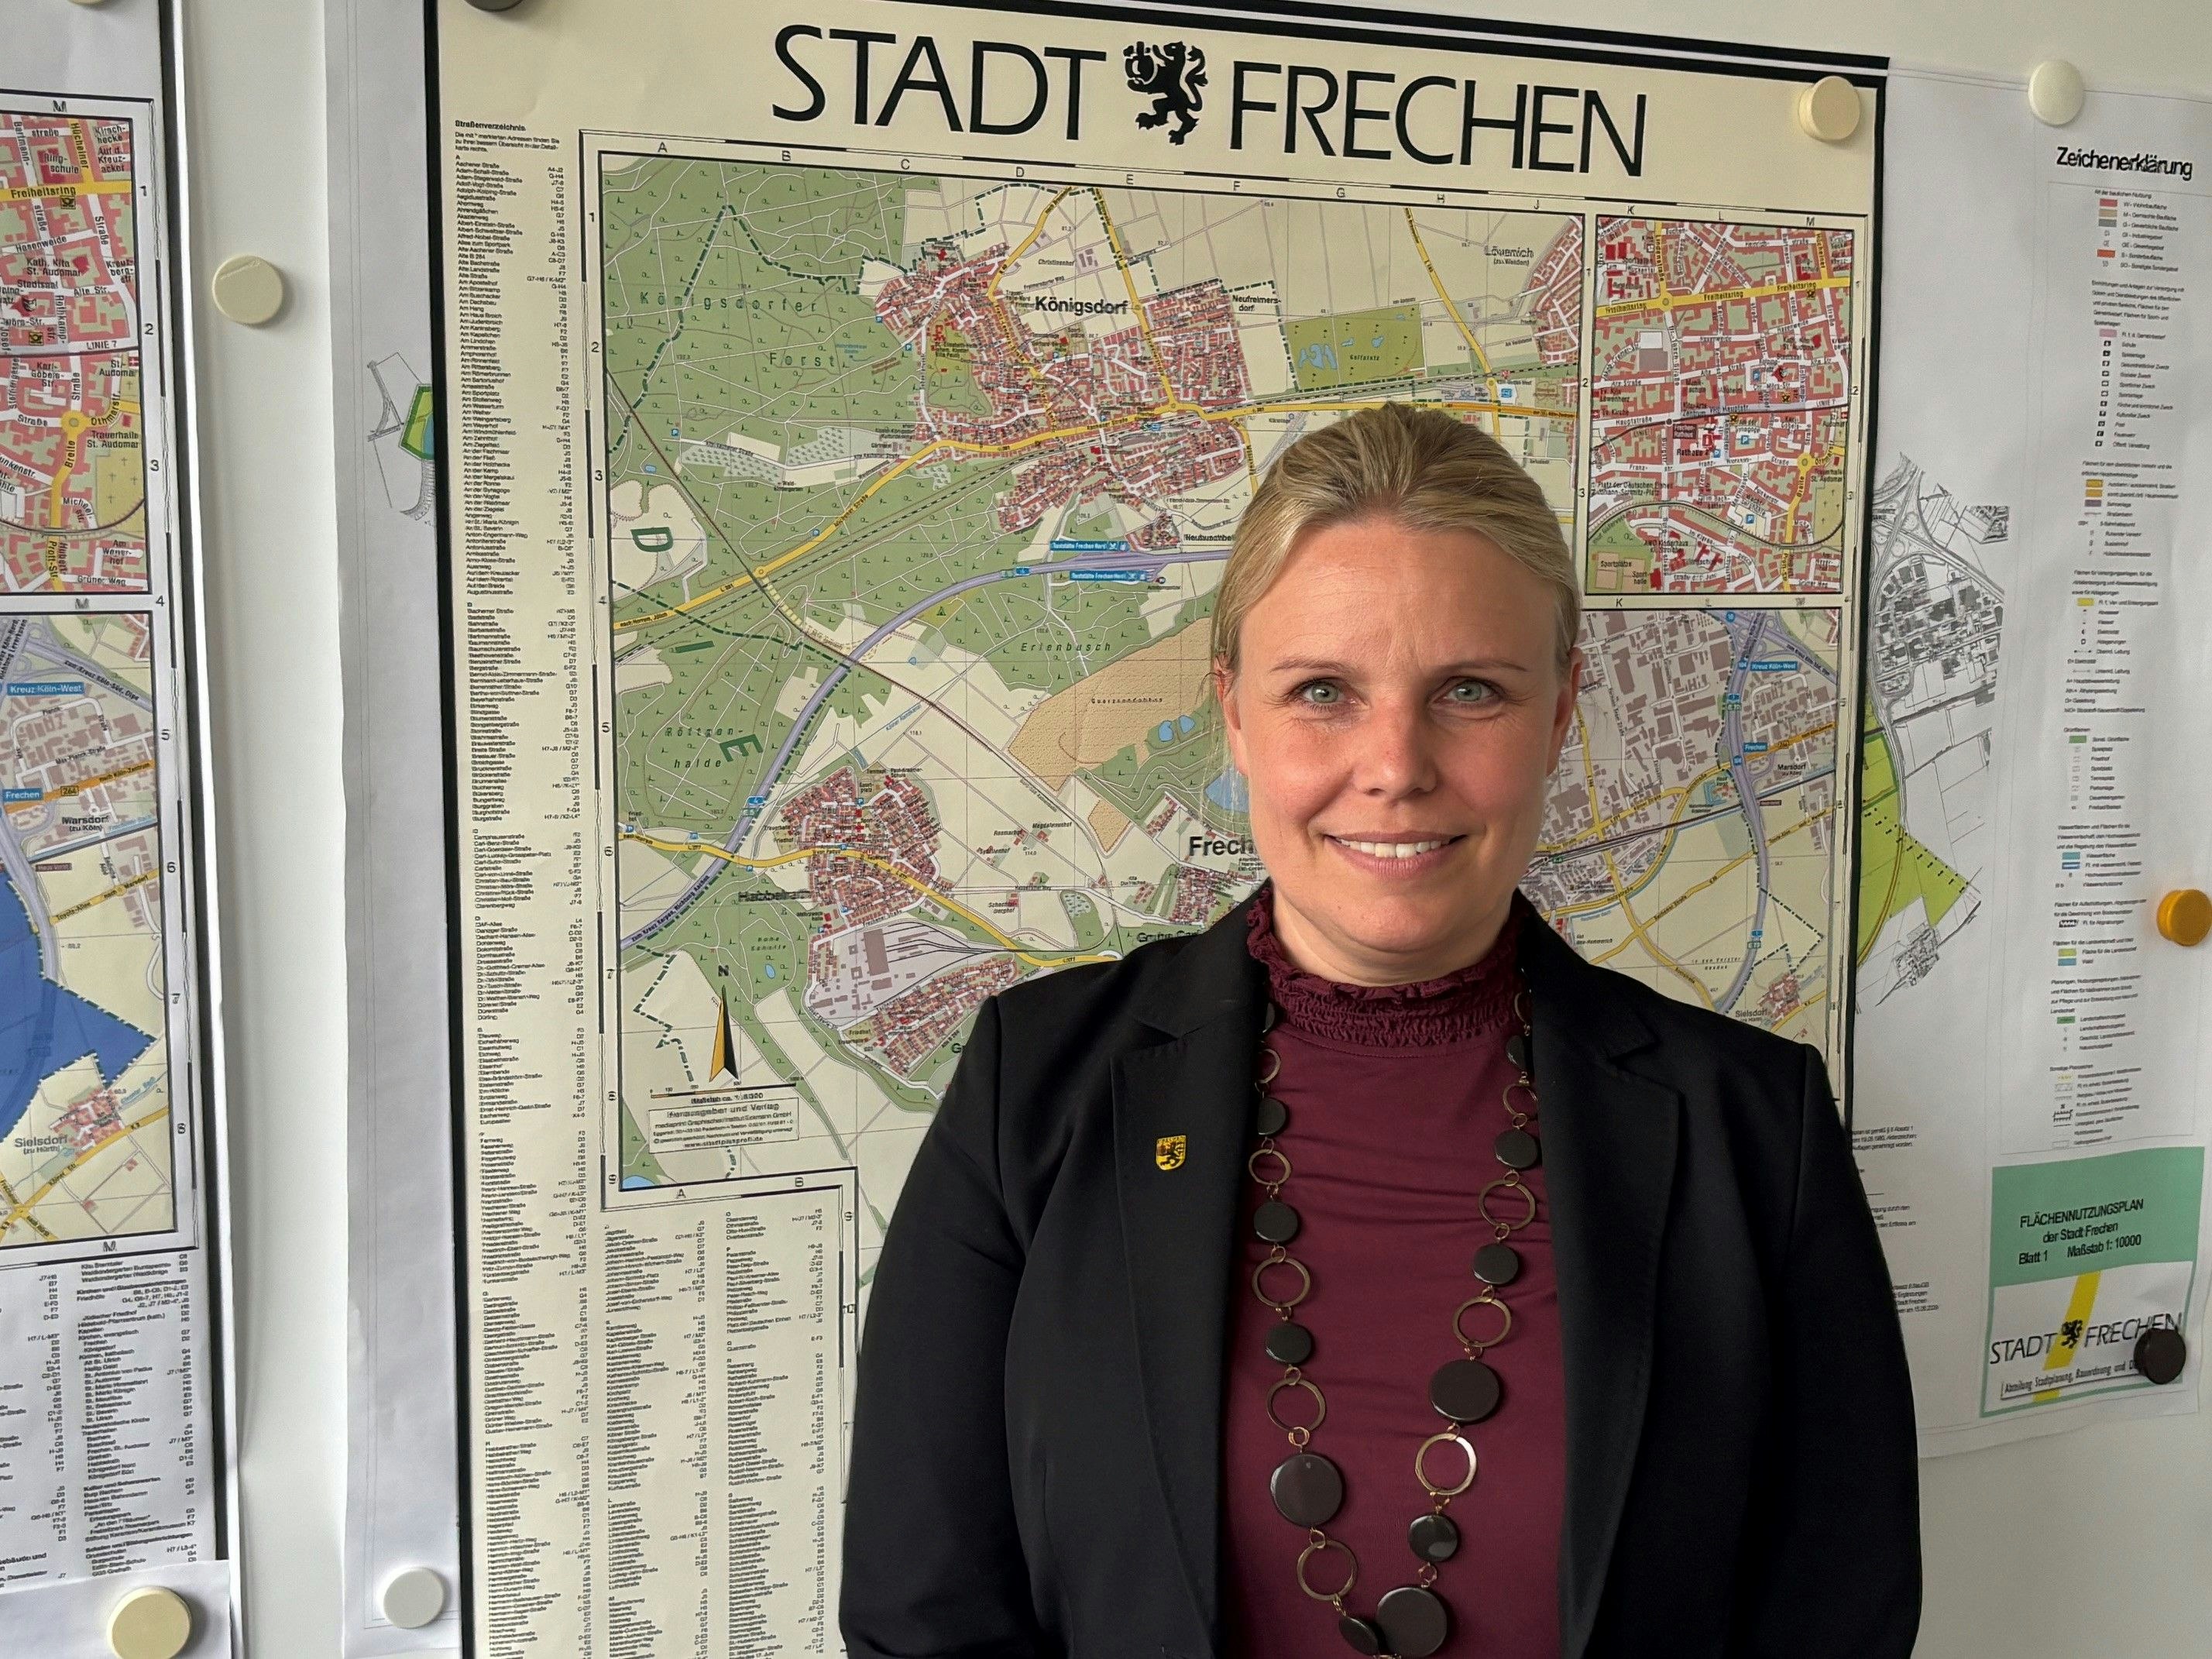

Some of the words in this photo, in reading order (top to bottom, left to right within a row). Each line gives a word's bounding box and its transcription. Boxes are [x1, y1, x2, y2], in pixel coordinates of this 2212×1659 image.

[773, 25, 1106, 140] STADT
[1231, 61, 1646, 177] FRECHEN
[658, 143, 668, 152] A
[781, 151, 792, 161] B
[901, 160, 910, 170] C
[2056, 146, 2193, 181] Zeichenerklärung
[1016, 167, 1025, 177] D
[1126, 174, 1134, 184] E
[1234, 181, 1241, 191] F
[1337, 187, 1345, 198] G
[1534, 199, 1540, 210] J
[1627, 206, 1635, 215] K
[588, 213, 594, 222] 1
[1719, 211, 1724, 221] L
[1806, 217, 1815, 226] M
[1035, 297, 1128, 315] Königsdorf
[144, 323, 154, 335] 2
[592, 342, 600, 353] 2
[595, 470, 603, 481] 3
[155, 595, 165, 606] 4
[1021, 642, 1111, 652] Erlenbusch
[10, 685, 36, 694] Kreuz
[37, 684, 82, 694] Köln-West
[602, 722, 610, 733] 5
[674, 758, 721, 768] halde
[5, 791, 40, 800] Frechen
[62, 816, 108, 826] Marsdorf
[167, 862, 177, 873] 6
[2020, 1200, 2144, 1228] FLÄCHENNUTZUNGSPLAN
[2042, 1231, 2059, 1244] der
[2060, 1227, 2083, 1242] Stadt
[2085, 1221, 2118, 1238] Frechen
[2018, 1252, 2040, 1265] Blatt
[2042, 1250, 2048, 1262] 1
[2067, 1242, 2104, 1258] Maßstab
[2114, 1235, 2142, 1249] 10000
[1990, 1333, 2057, 1365] STADT
